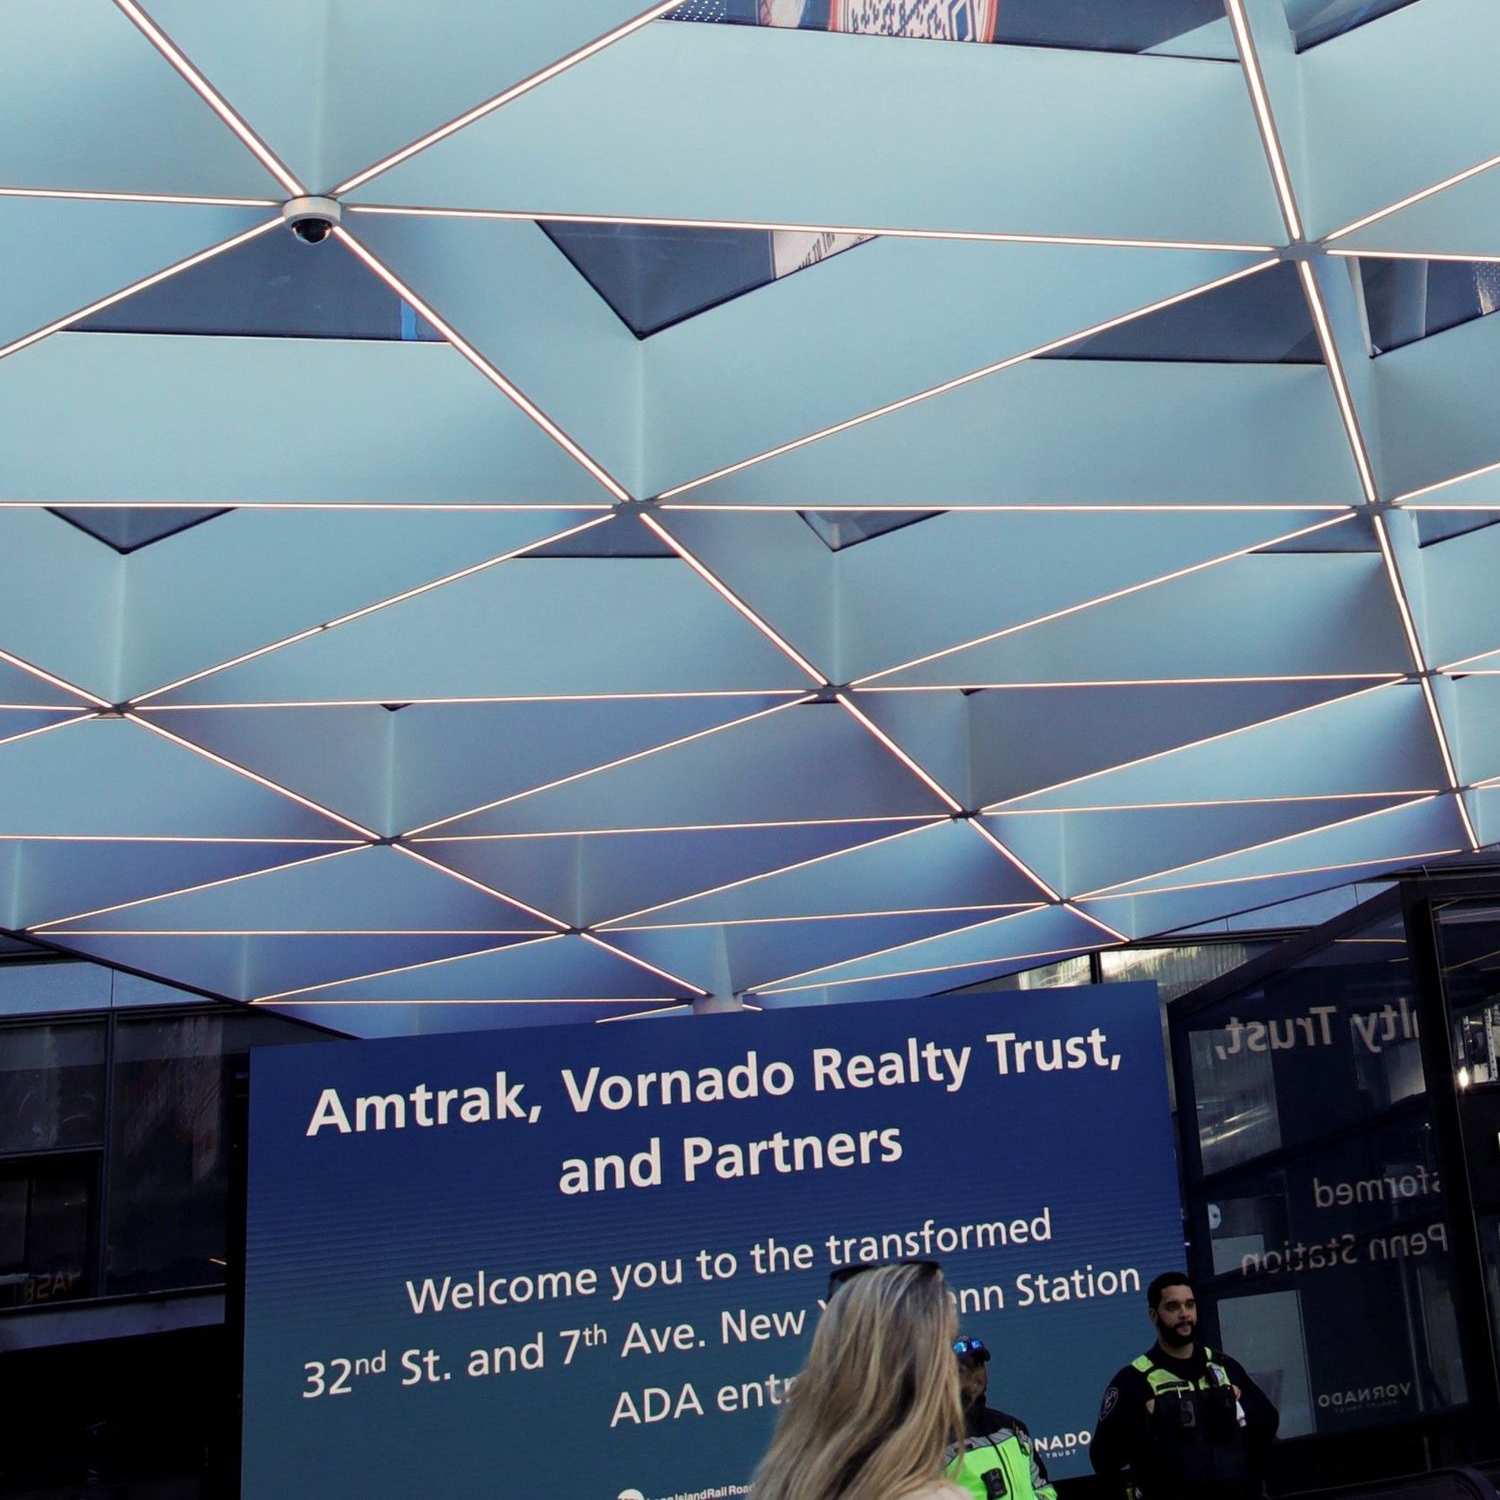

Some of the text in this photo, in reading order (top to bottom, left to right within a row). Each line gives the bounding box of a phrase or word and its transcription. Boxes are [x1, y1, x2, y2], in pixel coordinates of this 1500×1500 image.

[306, 1028, 1122, 1136] Amtrak, Vornado Realty Trust,
[559, 1120, 902, 1195] and Partners
[406, 1207, 1051, 1314] Welcome you to the transformed
[303, 1349, 387, 1398] 32nd
[401, 1349, 451, 1385] St.
[467, 1333, 544, 1377] and
[559, 1324, 607, 1365] 7th
[621, 1322, 705, 1357] Ave.
[721, 1309, 806, 1344] New
[1016, 1264, 1140, 1306] Station
[610, 1373, 796, 1427] ADA entr
[1033, 1430, 1092, 1452] NADO
[1045, 1448, 1077, 1459] TRUST
[707, 1485, 728, 1499] Rail
